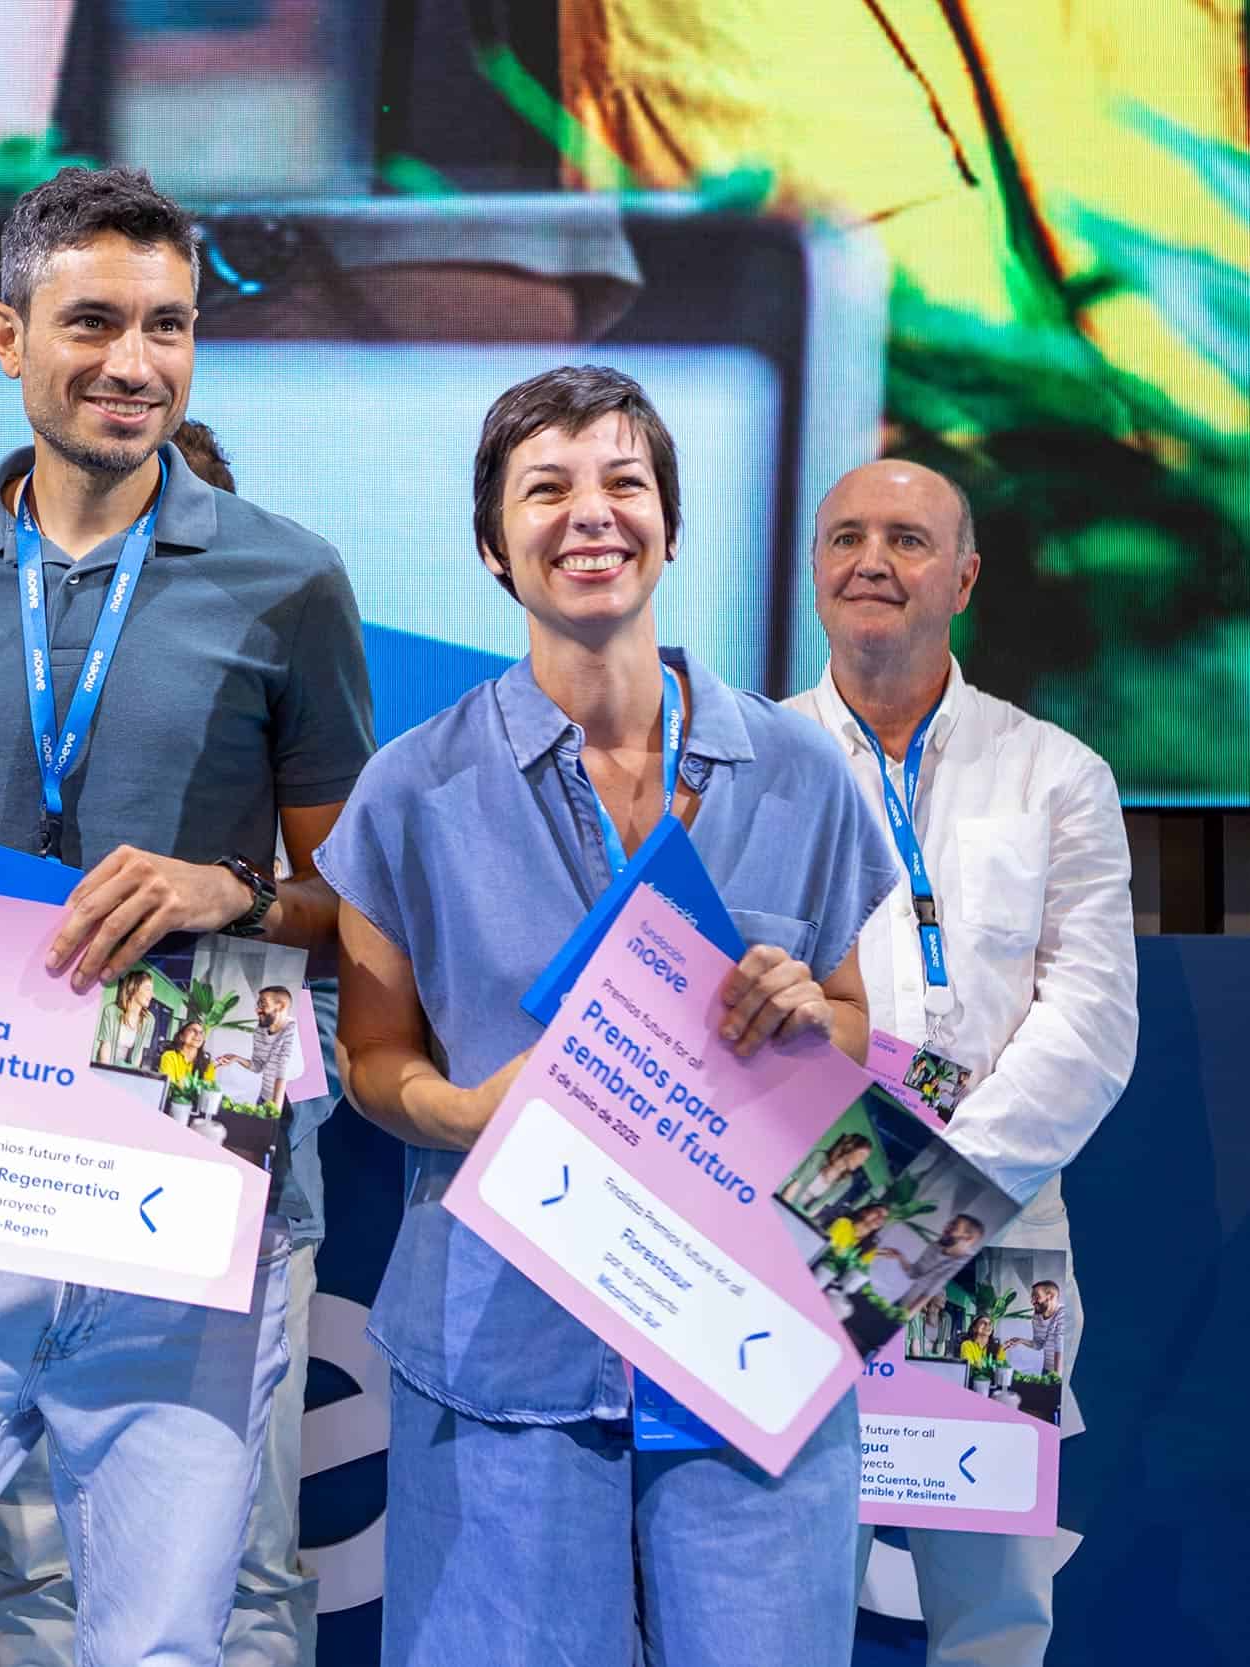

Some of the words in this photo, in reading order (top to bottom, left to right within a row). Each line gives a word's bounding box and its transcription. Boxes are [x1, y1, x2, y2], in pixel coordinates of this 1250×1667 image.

[29, 569, 38, 609] moeve
[110, 573, 130, 613] moeve
[33, 649, 46, 691] moeve
[84, 650, 103, 692] moeve
[54, 732, 76, 774] moeve
[627, 937, 688, 993] moeve
[602, 978, 641, 1022] Premios
[641, 1008, 672, 1045] future
[673, 1041, 689, 1059] for
[582, 1000, 670, 1089] Premios
[666, 1082, 729, 1138] para
[548, 1063, 559, 1076] 5
[556, 1072, 572, 1089] de
[568, 1081, 598, 1112] junio
[598, 1106, 612, 1124] de
[612, 1116, 641, 1146] 2025
[562, 1035, 657, 1120] sembrar
[657, 1115, 683, 1142] el
[679, 1132, 756, 1205] futuro
[28, 1146, 71, 1163] future
[75, 1153, 95, 1167] for
[98, 1159, 114, 1171] all
[861, 1443, 889, 1454] gua
[866, 1424, 900, 1436] future
[904, 1427, 919, 1437] for
[922, 1429, 935, 1438] all
[863, 1459, 894, 1470] yecto
[863, 1474, 874, 1483] ta
[877, 1474, 921, 1487] Cuenta,
[924, 1478, 945, 1488] Una
[862, 1486, 894, 1497] enible
[897, 1490, 905, 1499] y
